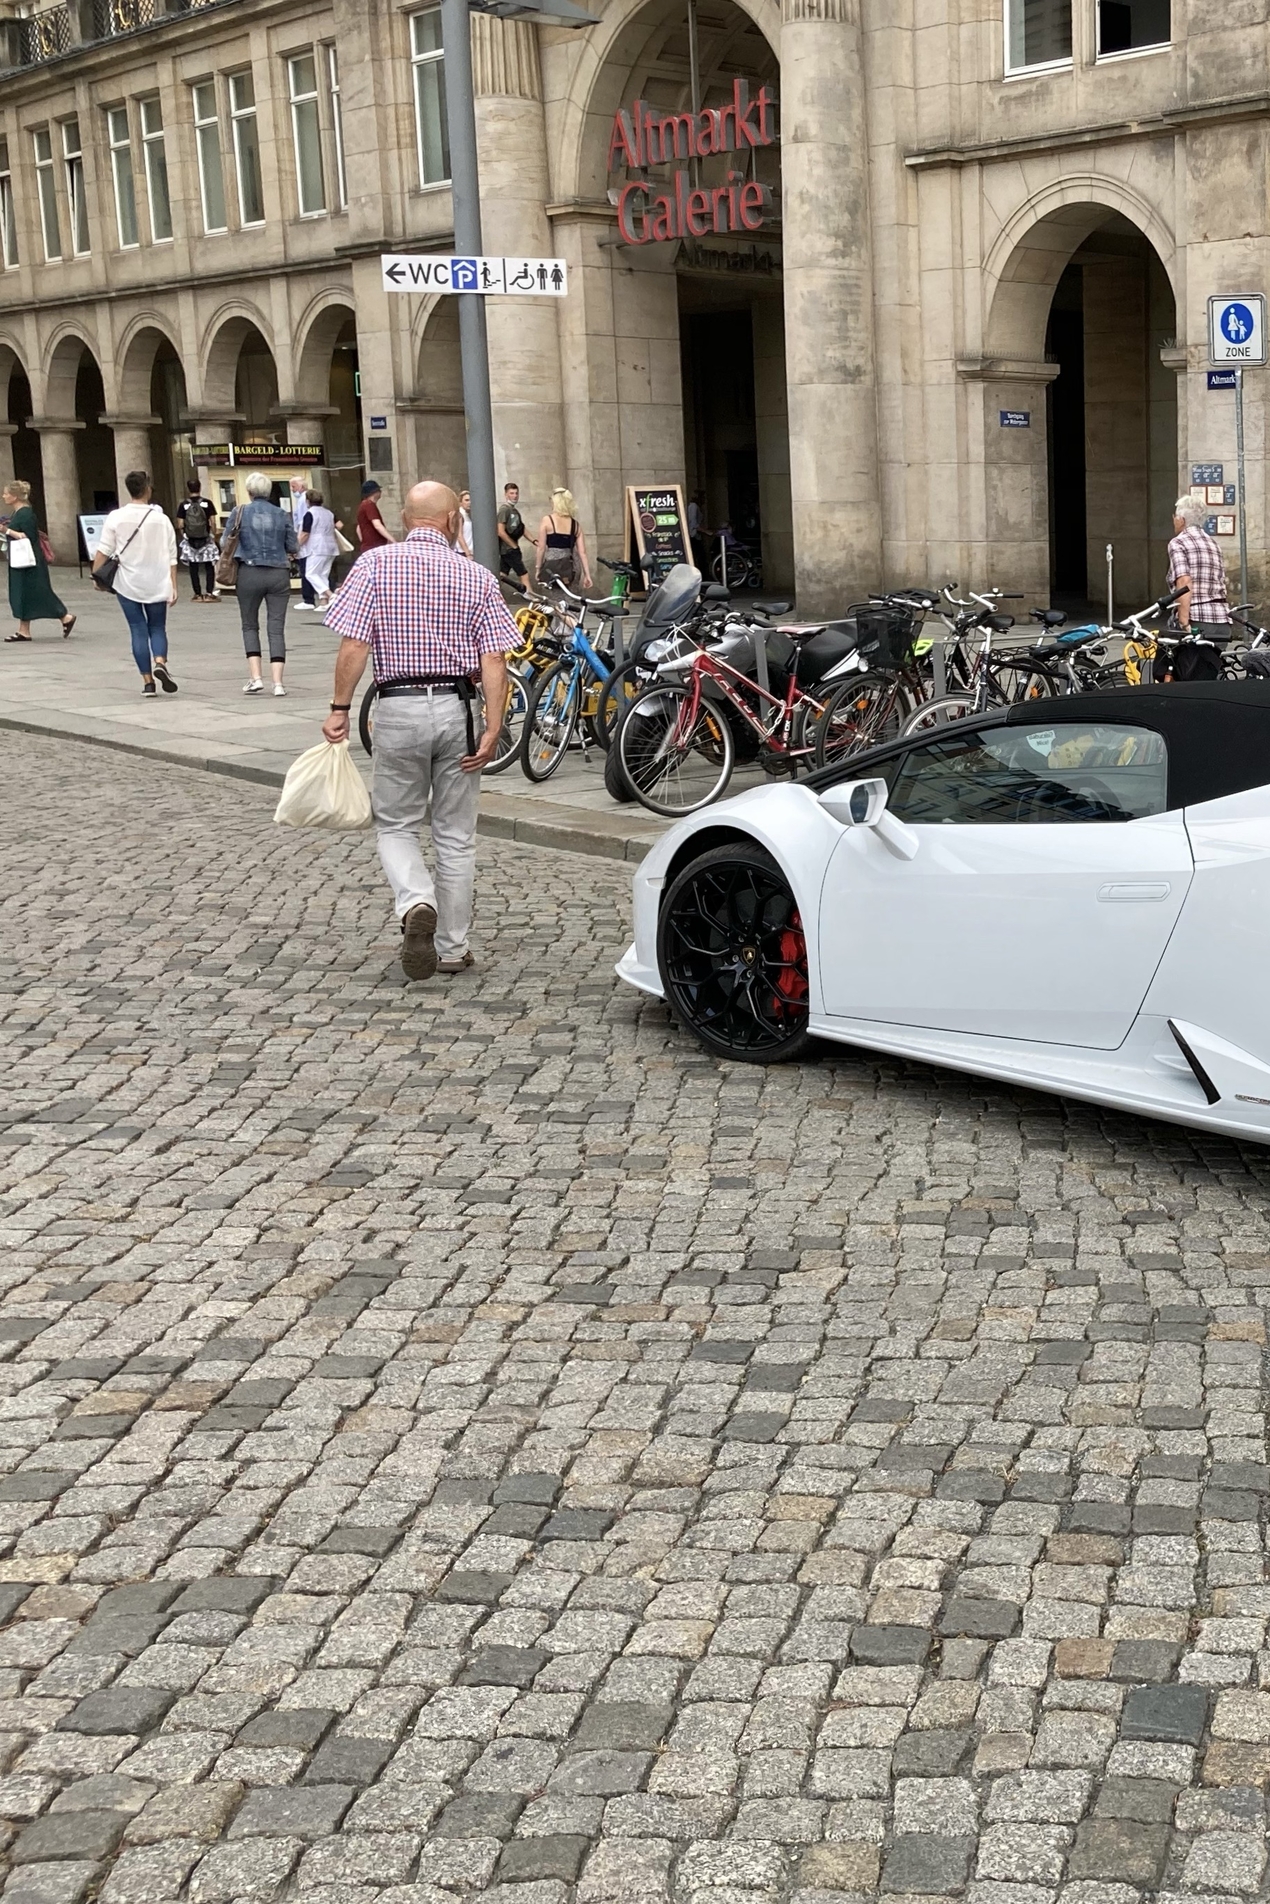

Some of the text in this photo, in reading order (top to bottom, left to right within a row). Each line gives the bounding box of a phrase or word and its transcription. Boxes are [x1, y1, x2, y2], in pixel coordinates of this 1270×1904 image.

[608, 78, 776, 172] Altmarkt
[618, 170, 770, 246] Galerie
[408, 263, 449, 285] WC
[1225, 347, 1251, 357] ZONE
[1210, 374, 1236, 385] Altmark
[234, 446, 274, 455] BARGELD
[280, 446, 321, 455] LOTTERIE
[658, 516, 667, 524] 25
